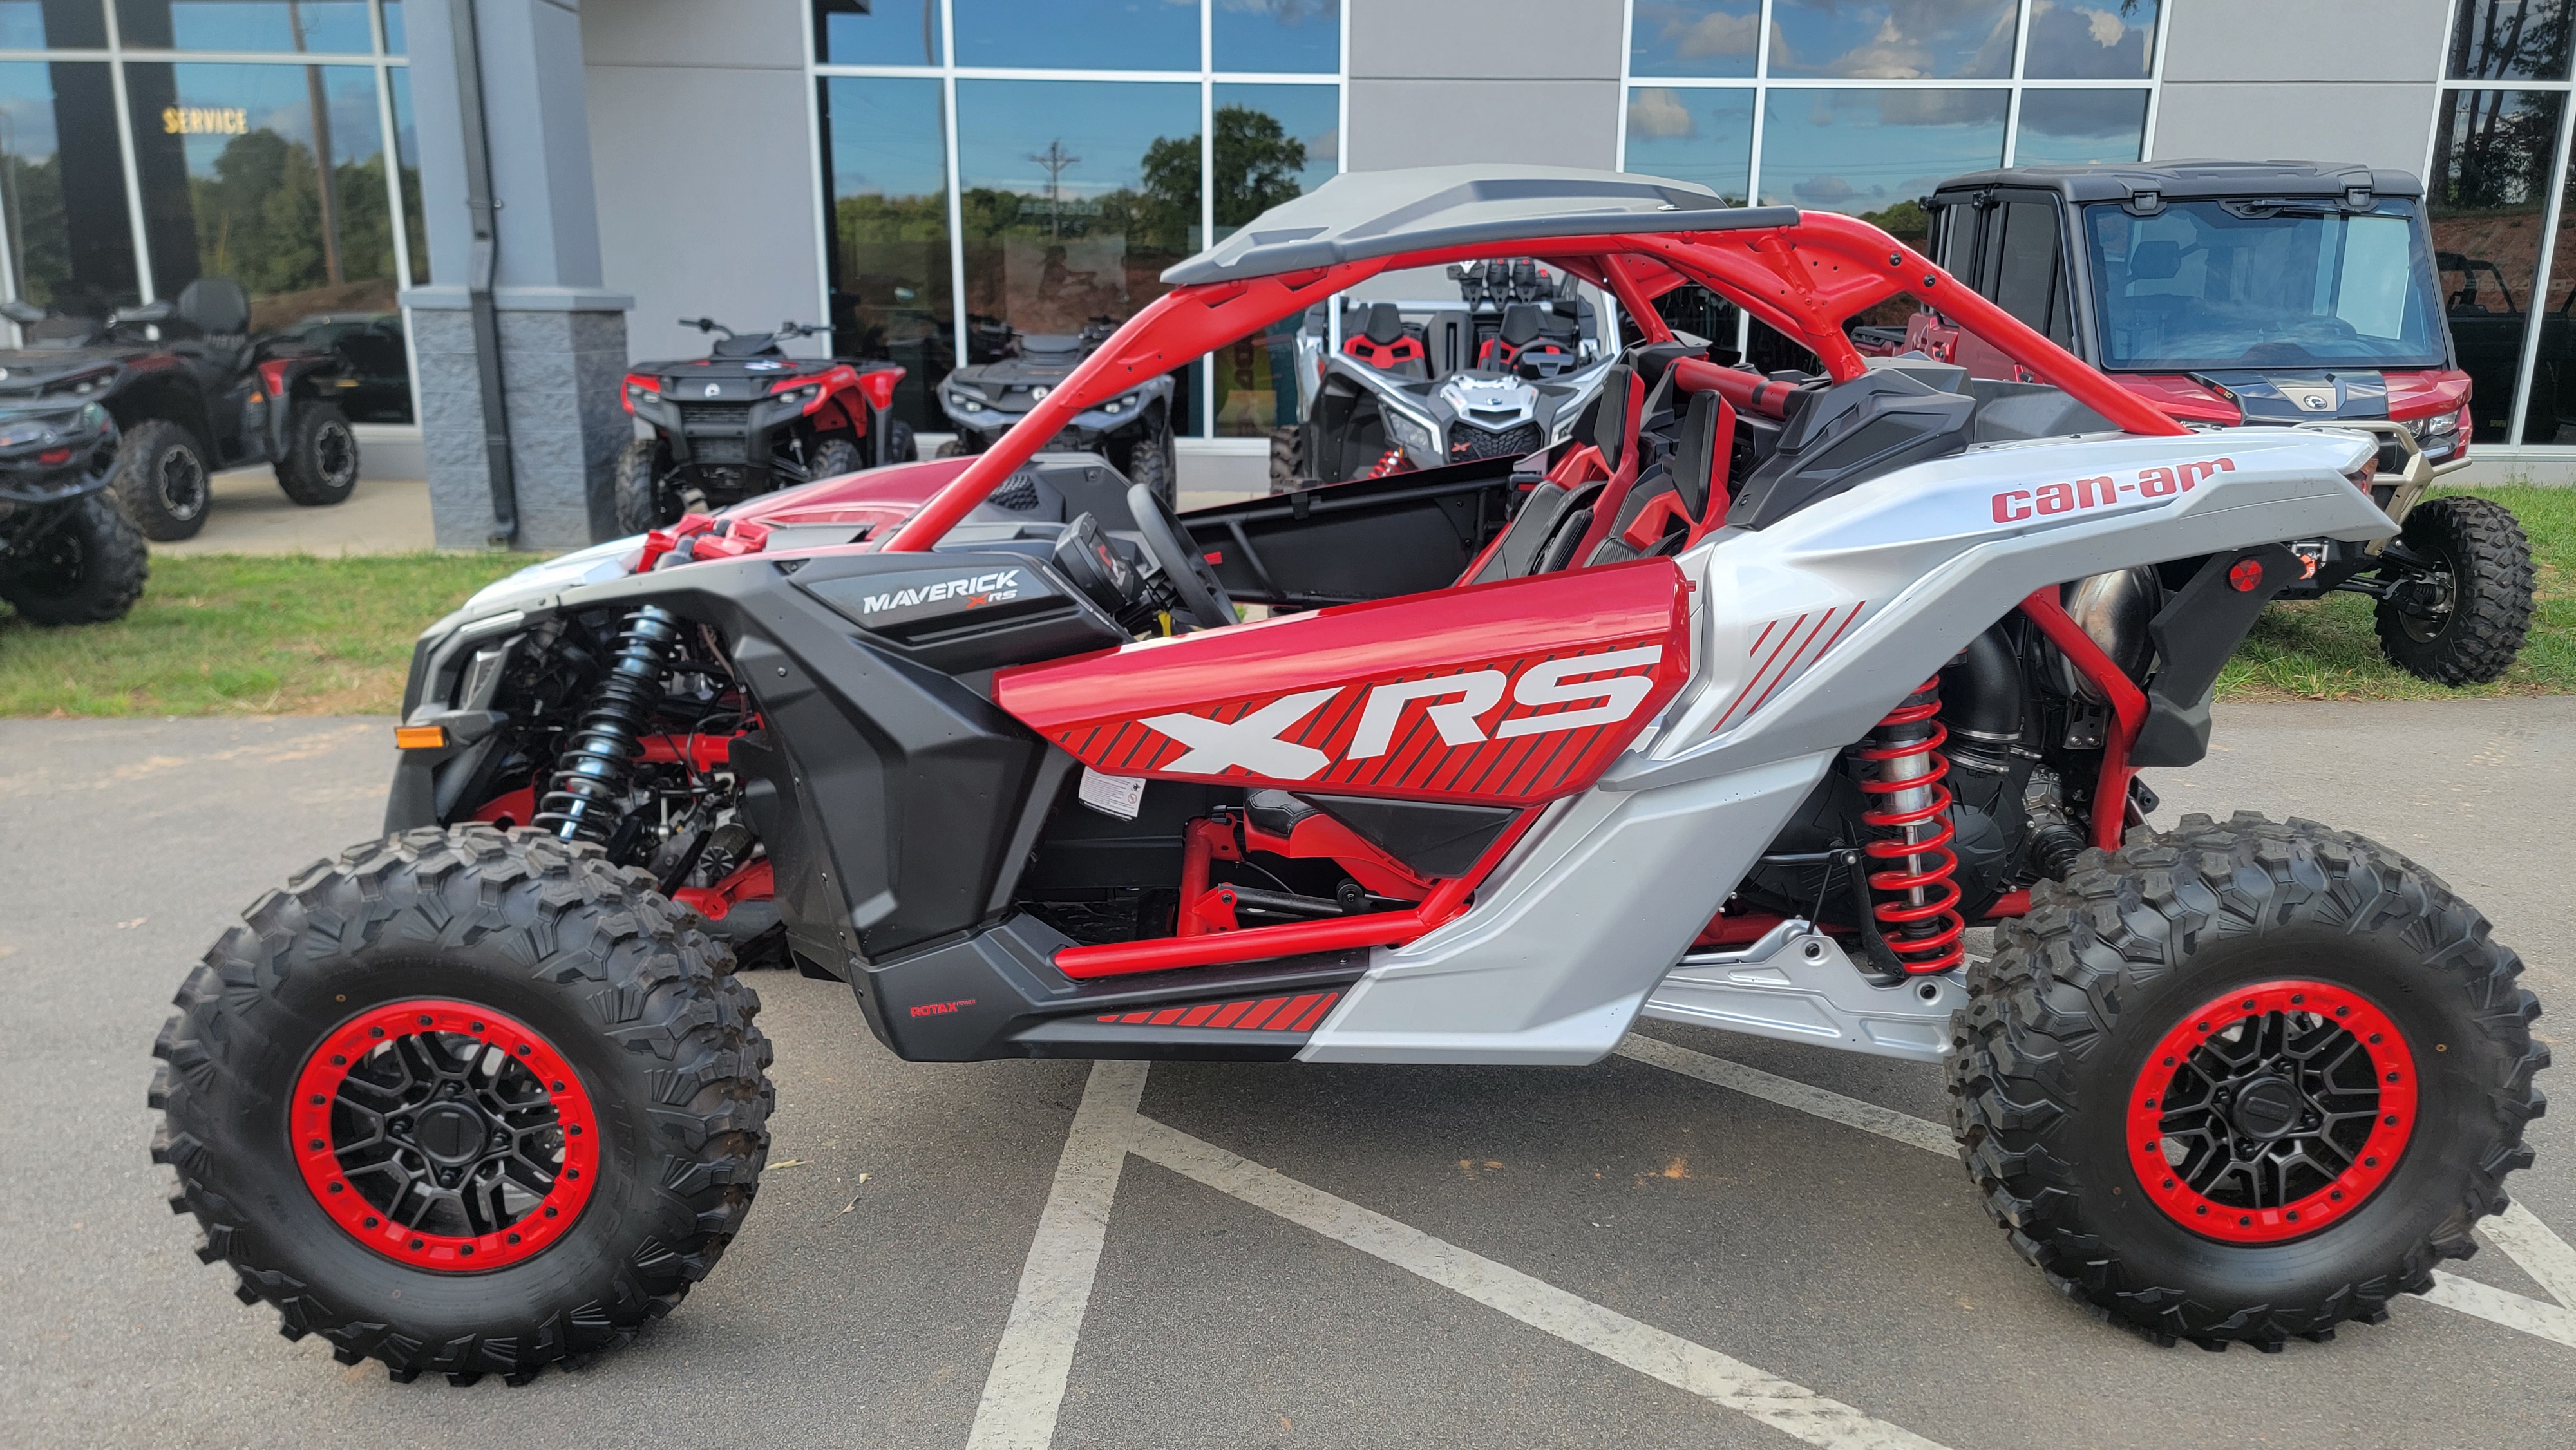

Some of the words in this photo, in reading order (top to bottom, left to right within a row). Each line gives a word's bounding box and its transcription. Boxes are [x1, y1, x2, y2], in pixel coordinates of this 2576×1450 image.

[163, 107, 249, 135] SERVICE
[1992, 458, 2236, 523] can-am
[863, 569, 1020, 614] MAVERICK
[1137, 645, 1662, 780] XRS
[910, 1003, 958, 1017] ROTAX
